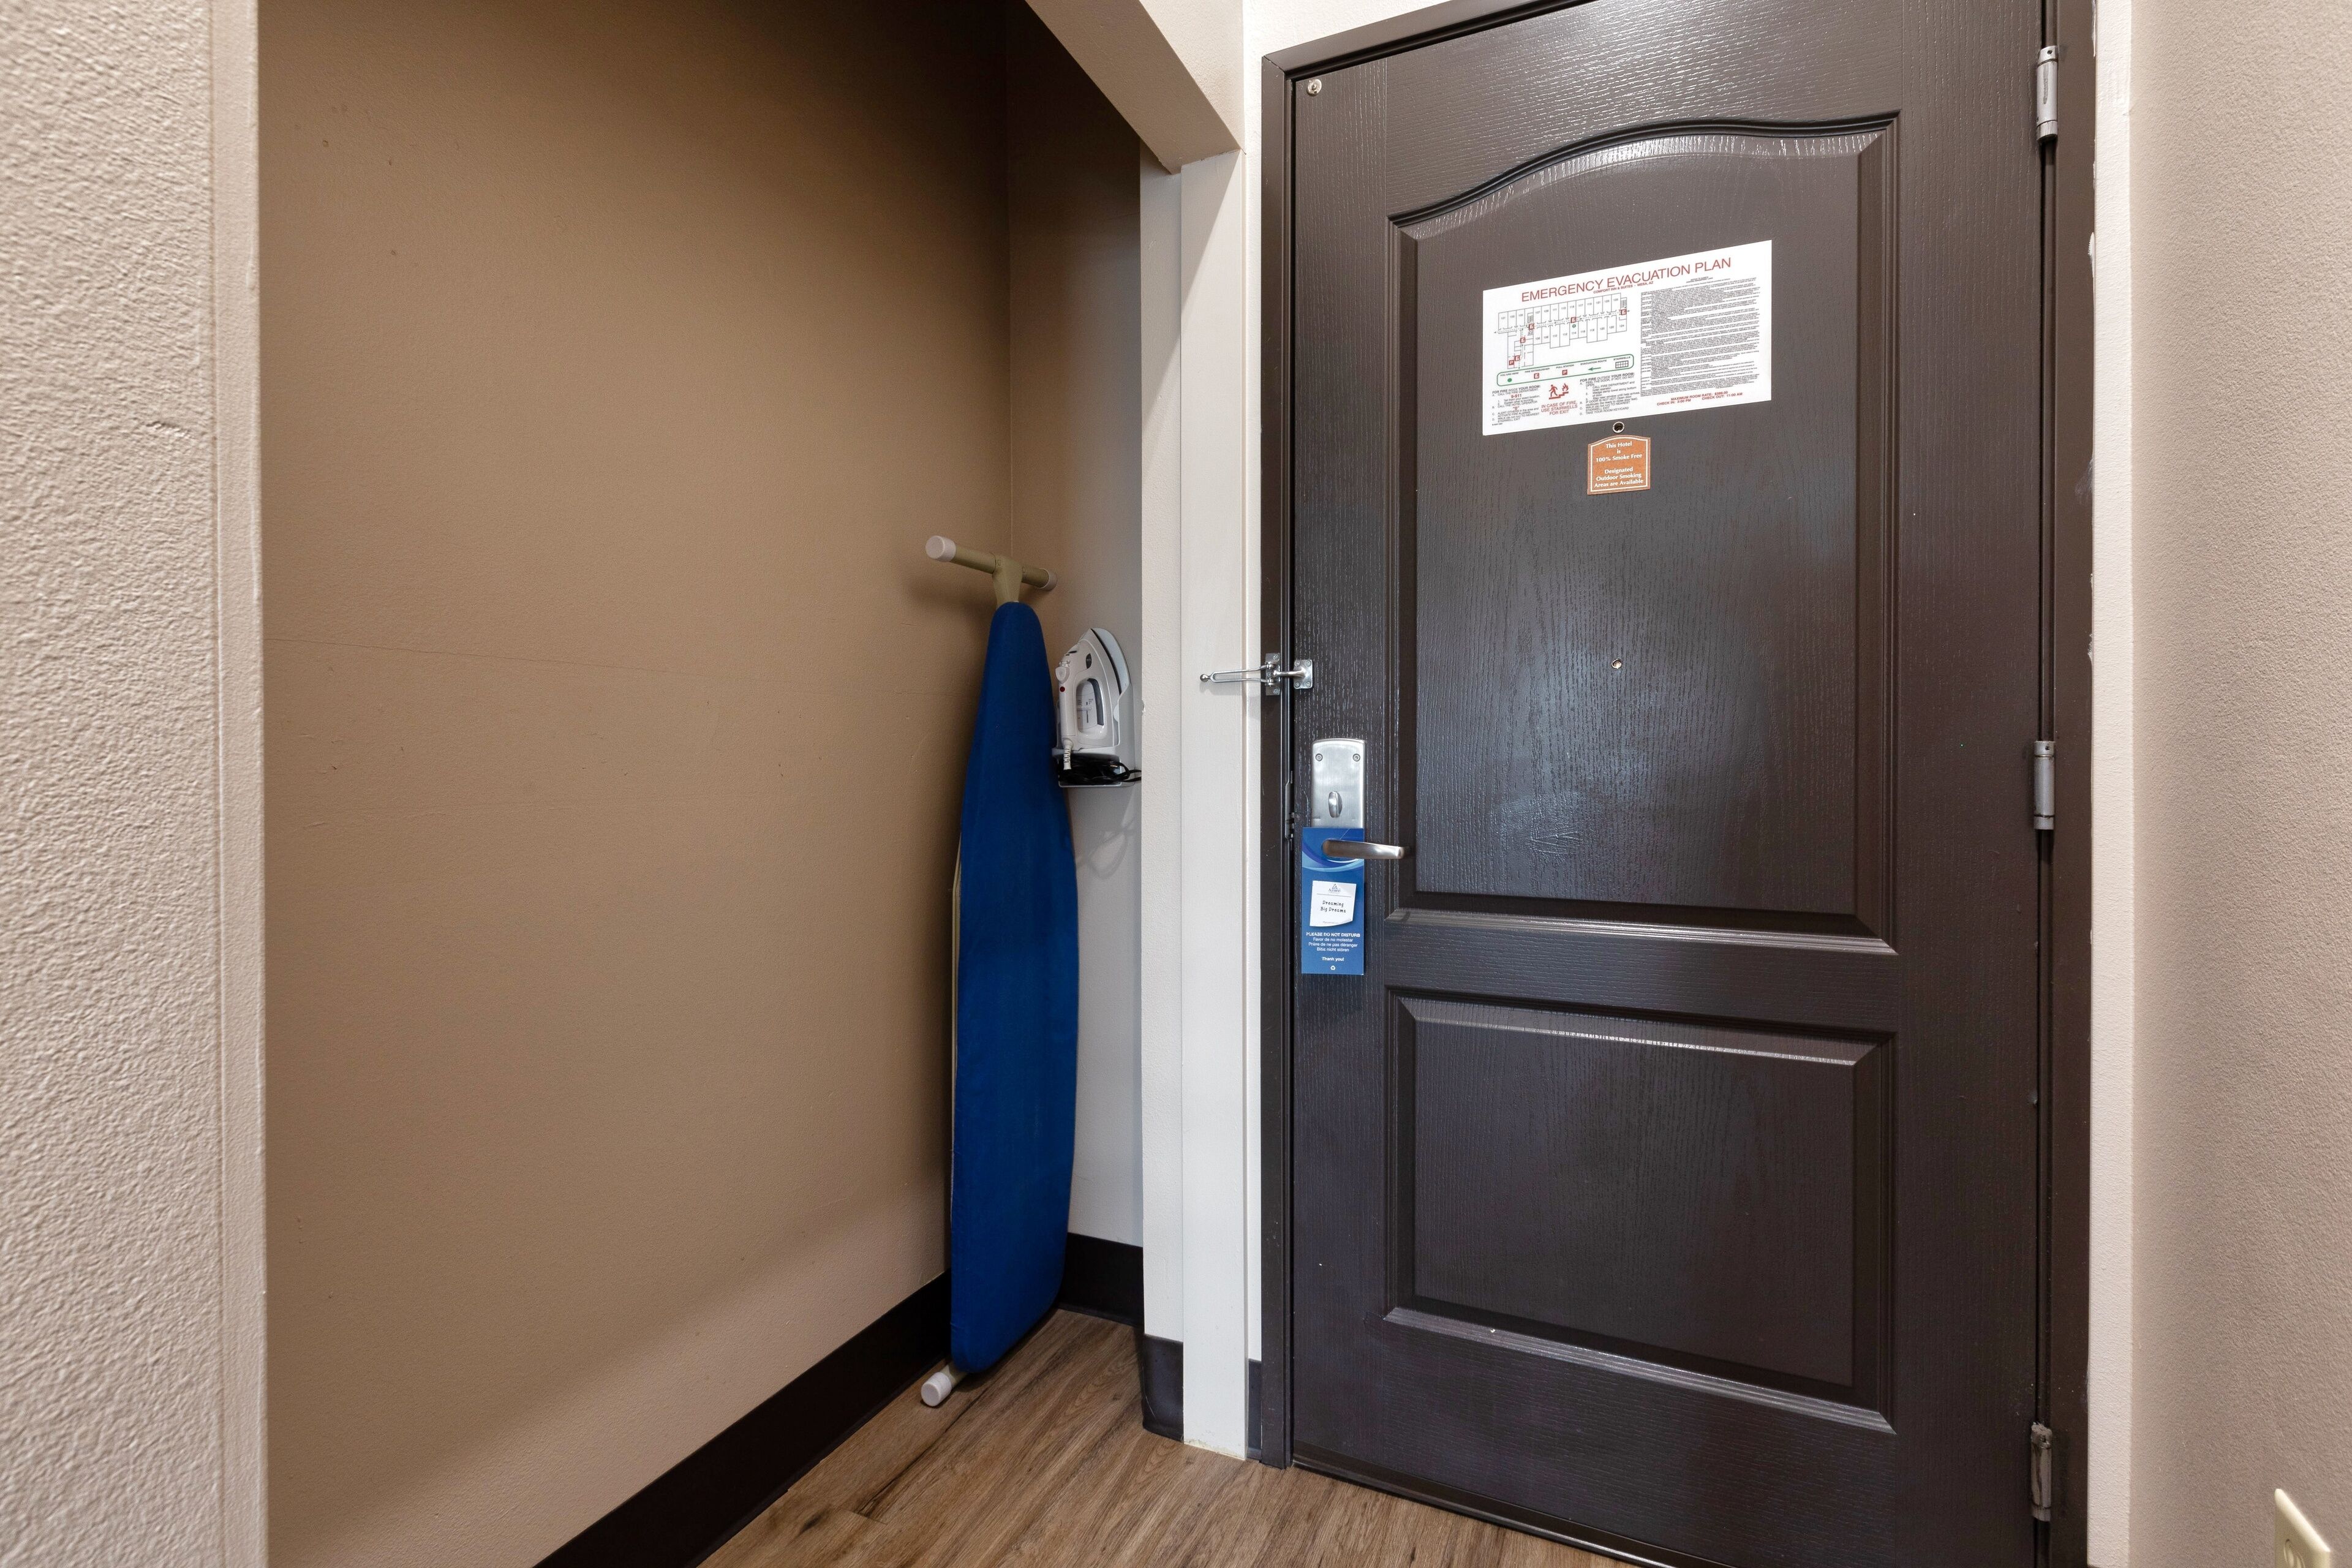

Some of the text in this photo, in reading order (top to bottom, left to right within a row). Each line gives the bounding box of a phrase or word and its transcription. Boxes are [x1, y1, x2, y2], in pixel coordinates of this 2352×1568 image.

[1521, 257, 1731, 302] EMERGENCY EVACUATION PLAN
